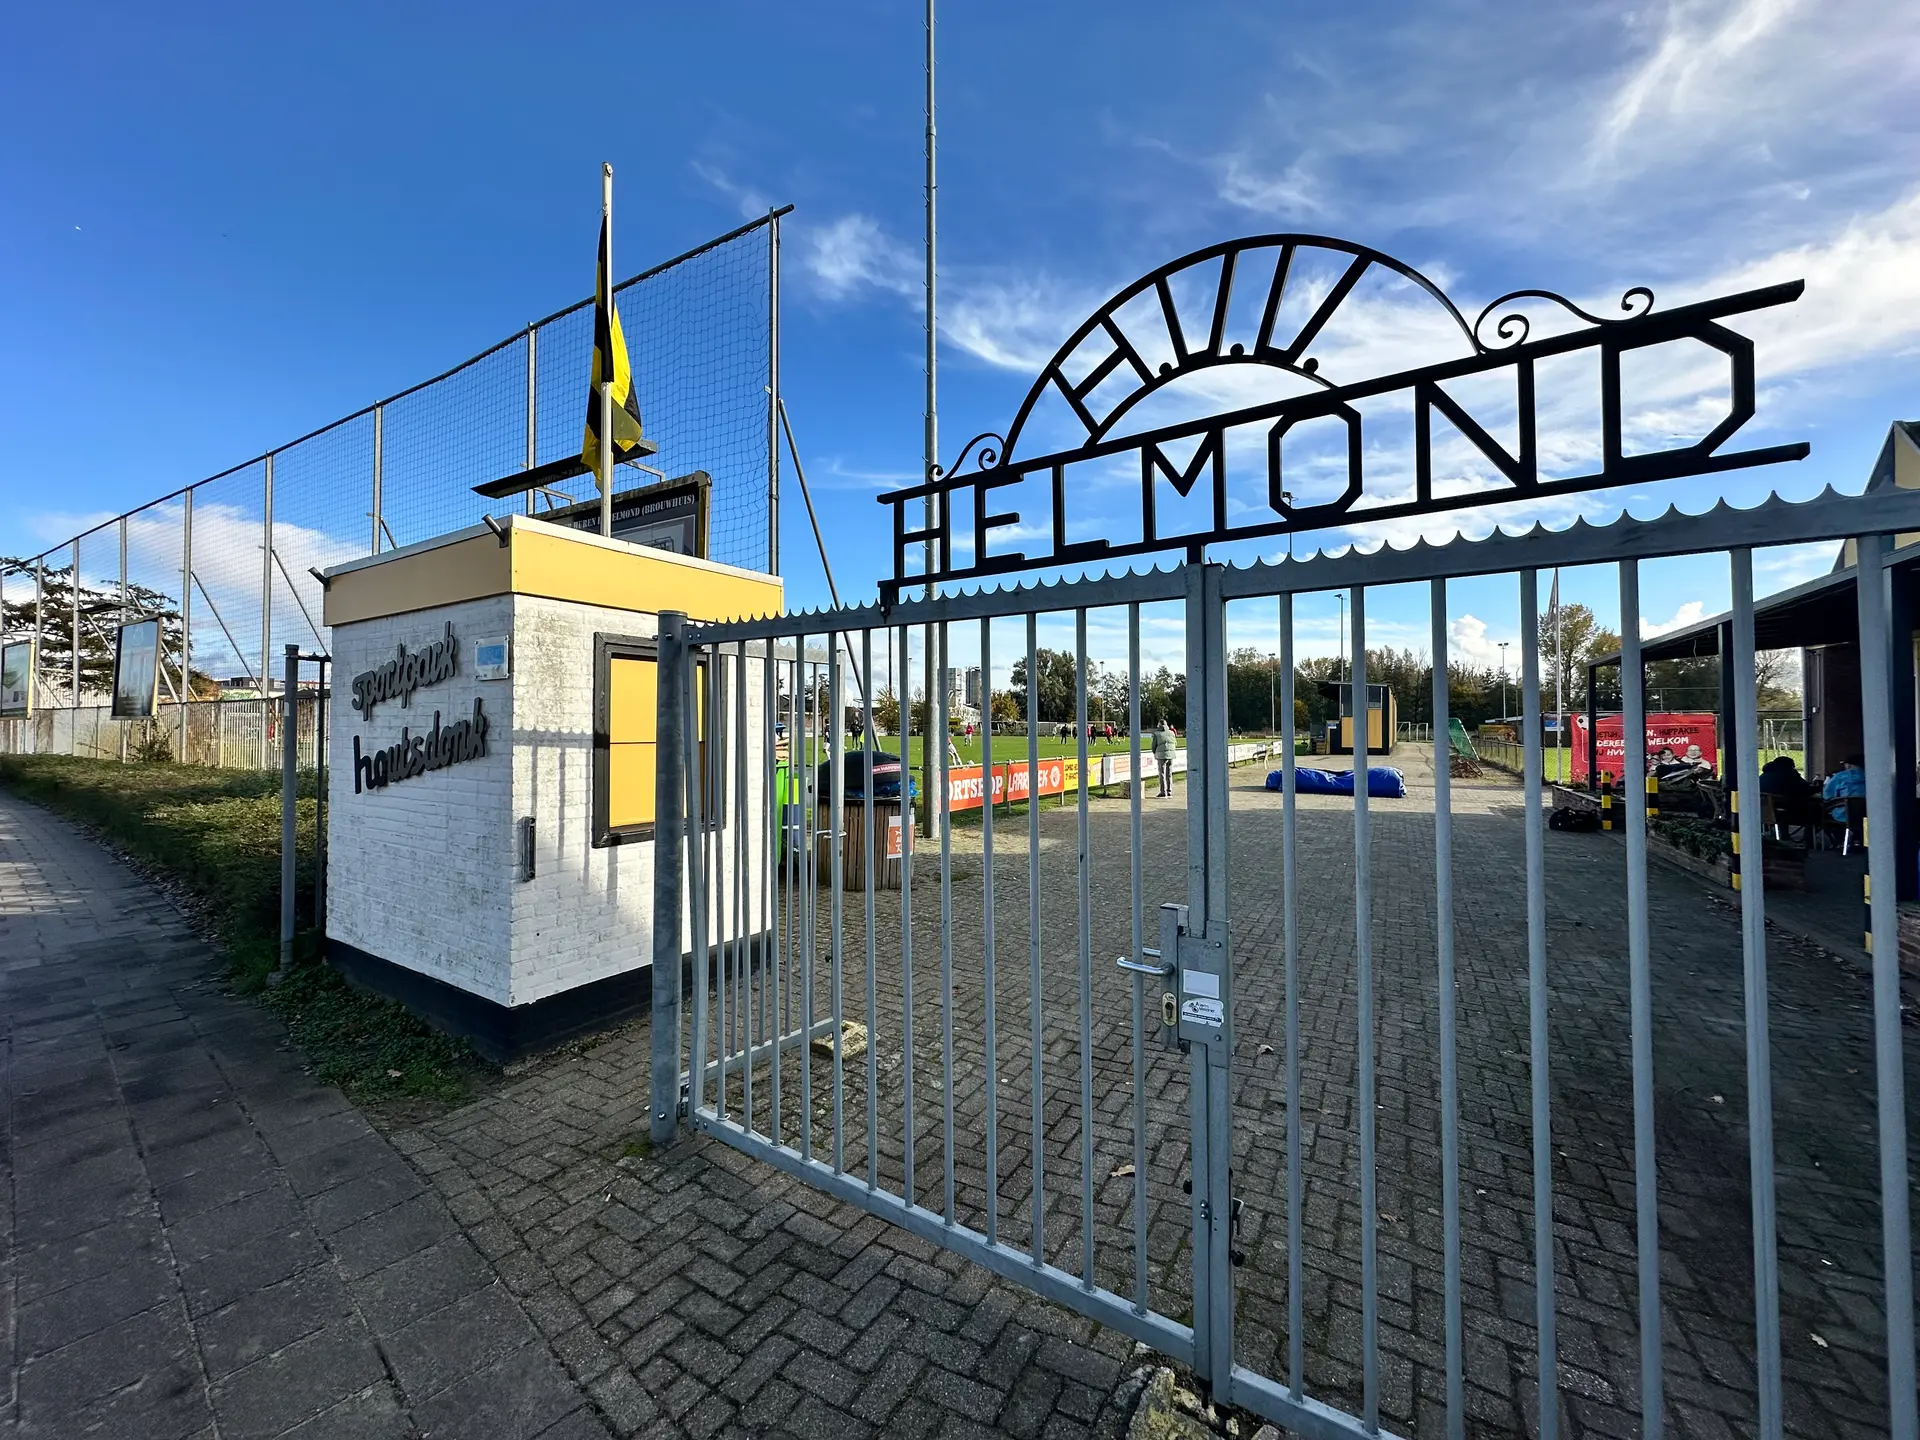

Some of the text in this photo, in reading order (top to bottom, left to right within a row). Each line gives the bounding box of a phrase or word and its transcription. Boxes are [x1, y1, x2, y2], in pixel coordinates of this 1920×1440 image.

[890, 316, 1758, 584] HELMOND
[611, 508, 640, 522] ELMOND
[641, 493, 696, 517] (BROUWHUIS)
[351, 620, 456, 722] sportpark
[353, 697, 487, 795] houtsdonk
[1596, 736, 1689, 748] DEREE WELKOM
[1008, 769, 1049, 793] LAAREK
